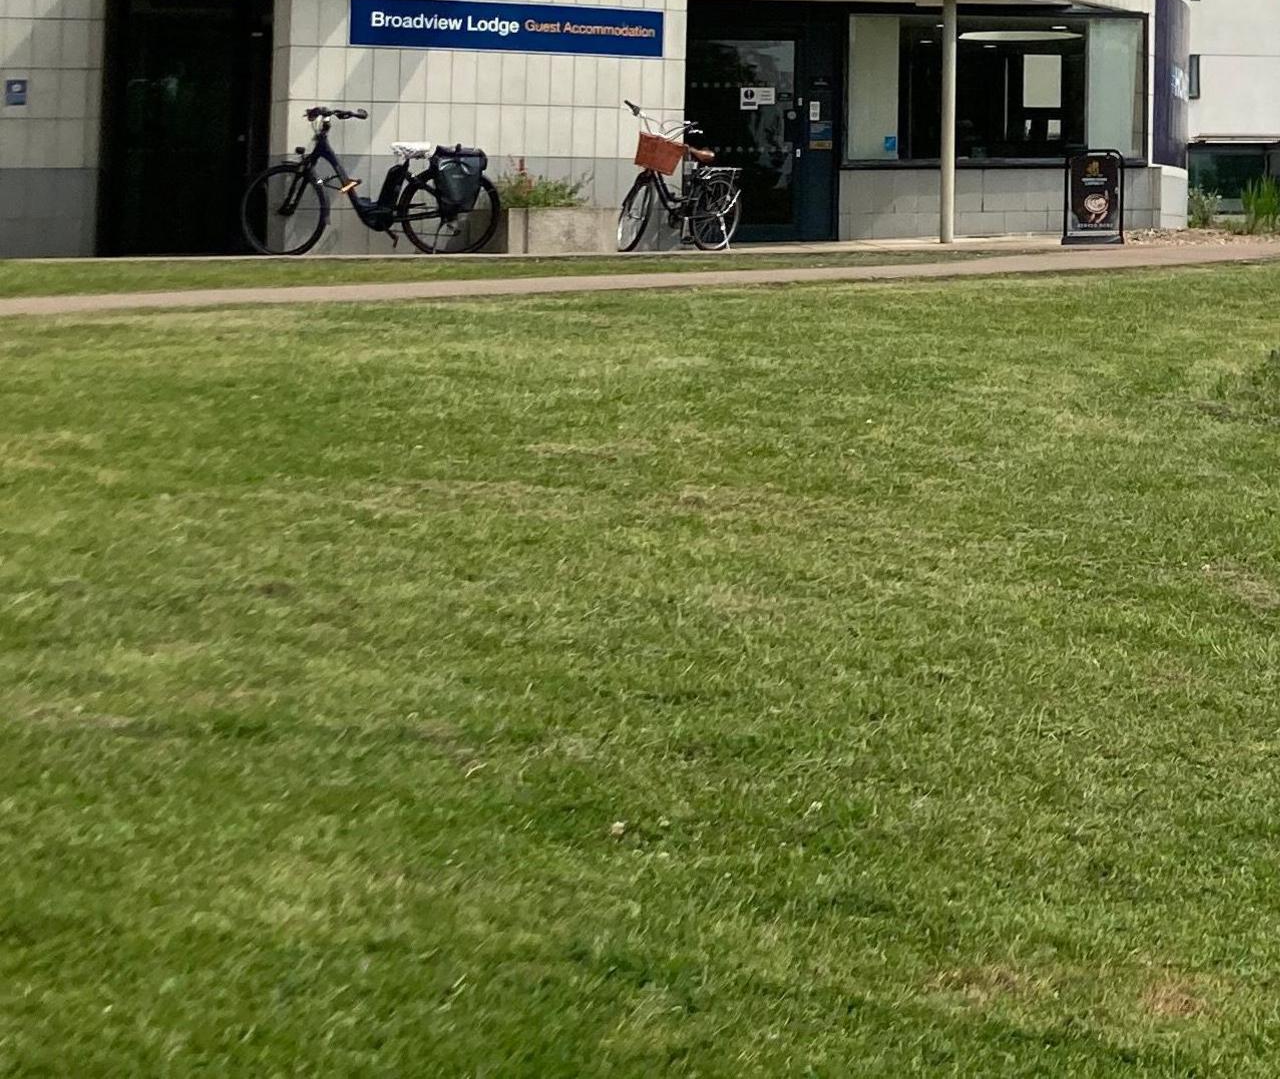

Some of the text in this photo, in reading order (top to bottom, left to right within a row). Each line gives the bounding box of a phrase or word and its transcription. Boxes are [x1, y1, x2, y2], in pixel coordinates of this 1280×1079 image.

[371, 11, 656, 38] Broadview Lodge Guest Accommodation
